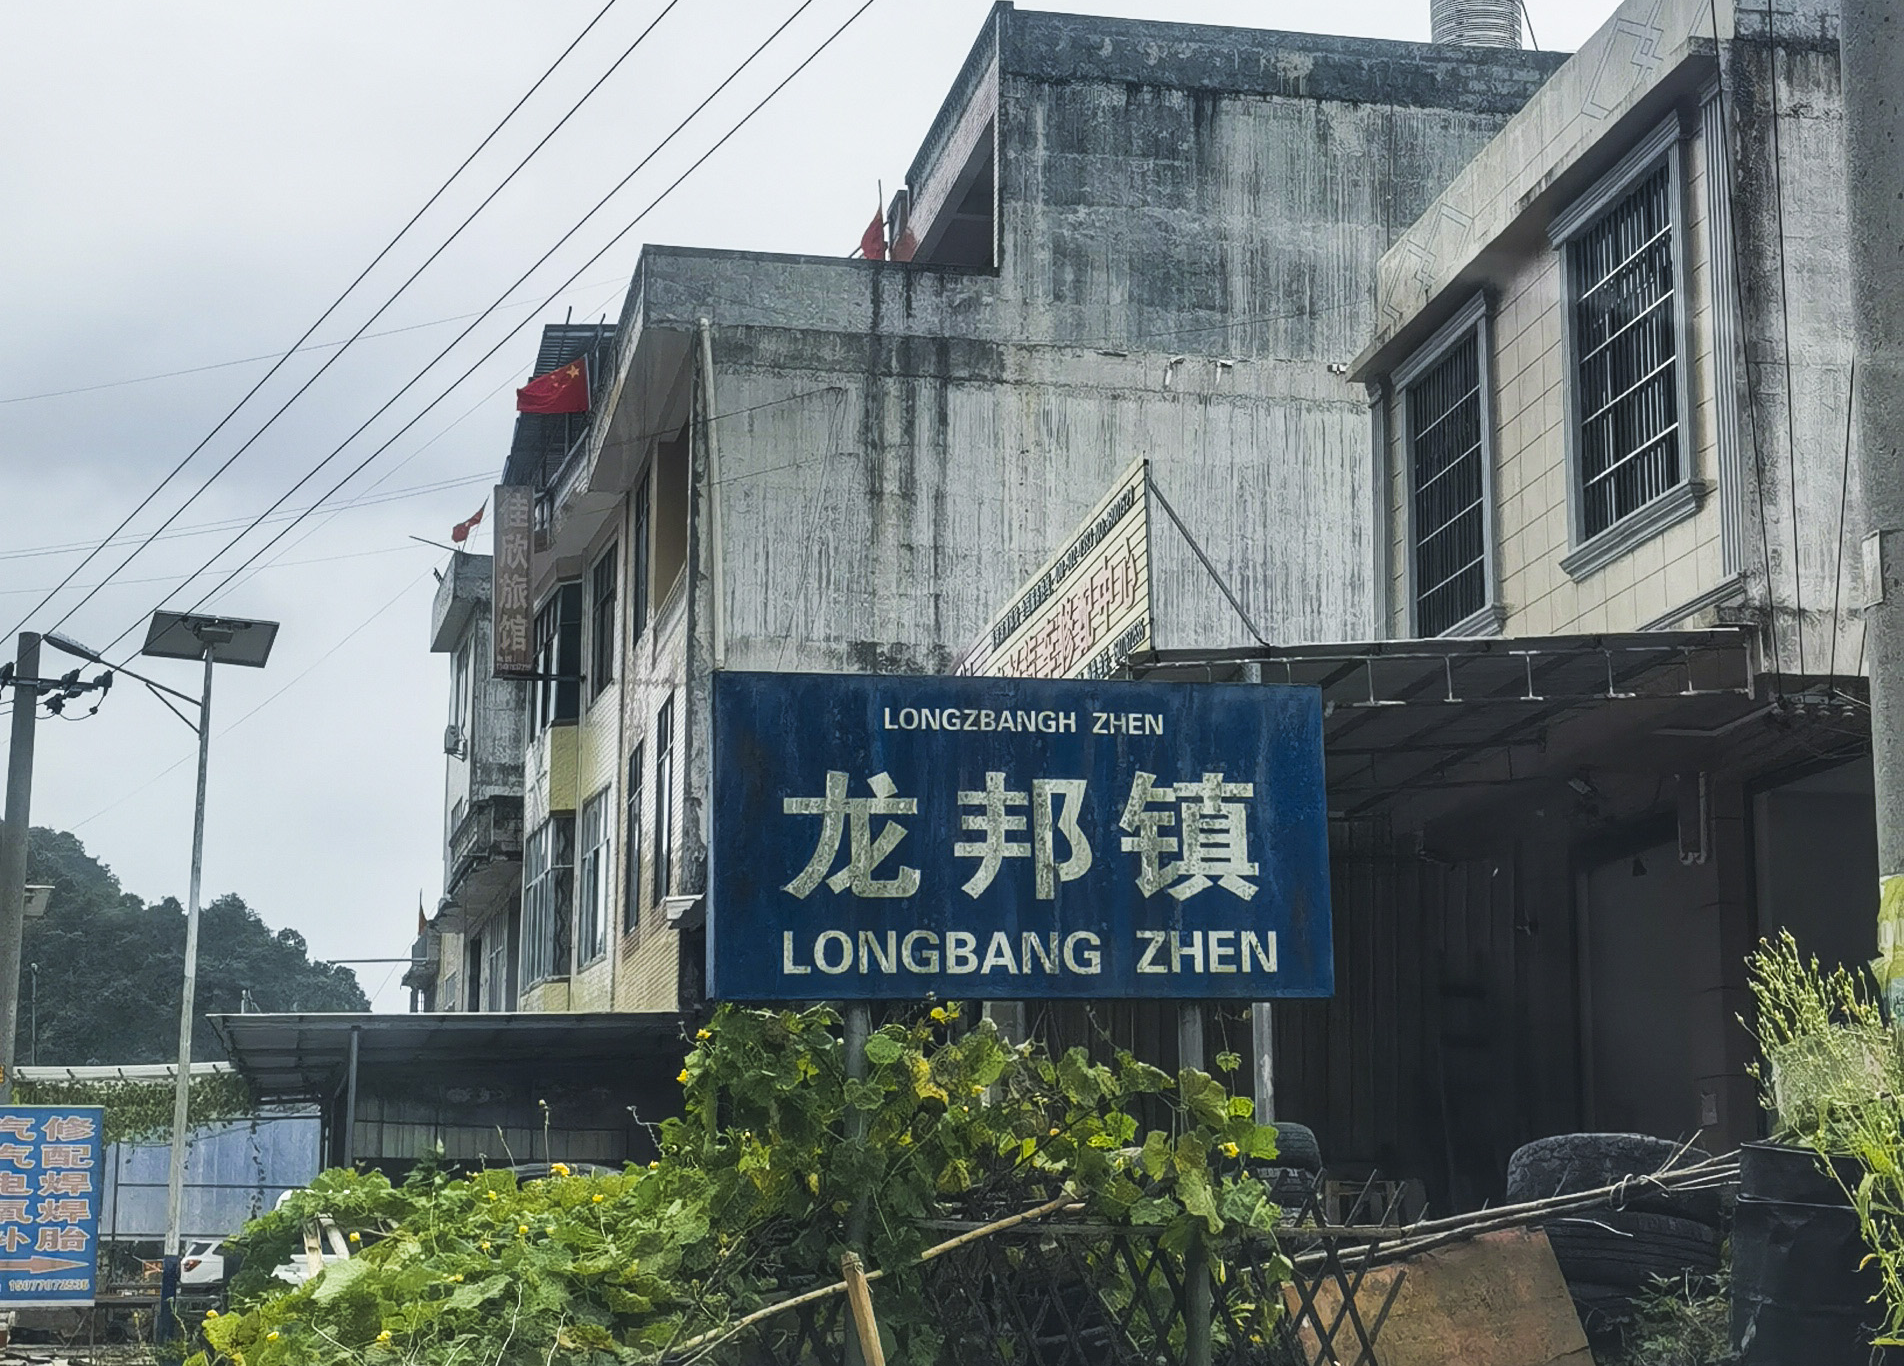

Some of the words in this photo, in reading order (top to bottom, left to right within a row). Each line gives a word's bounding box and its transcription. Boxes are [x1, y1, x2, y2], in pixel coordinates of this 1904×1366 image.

[499, 493, 530, 652] 佳欣旅馆
[883, 707, 1077, 734] LONGZBANGH
[1092, 711, 1165, 736] ZHEN
[780, 770, 1260, 903] 龙邦镇
[782, 930, 1102, 975] LONGBANG
[1136, 931, 1278, 974] ZHEN
